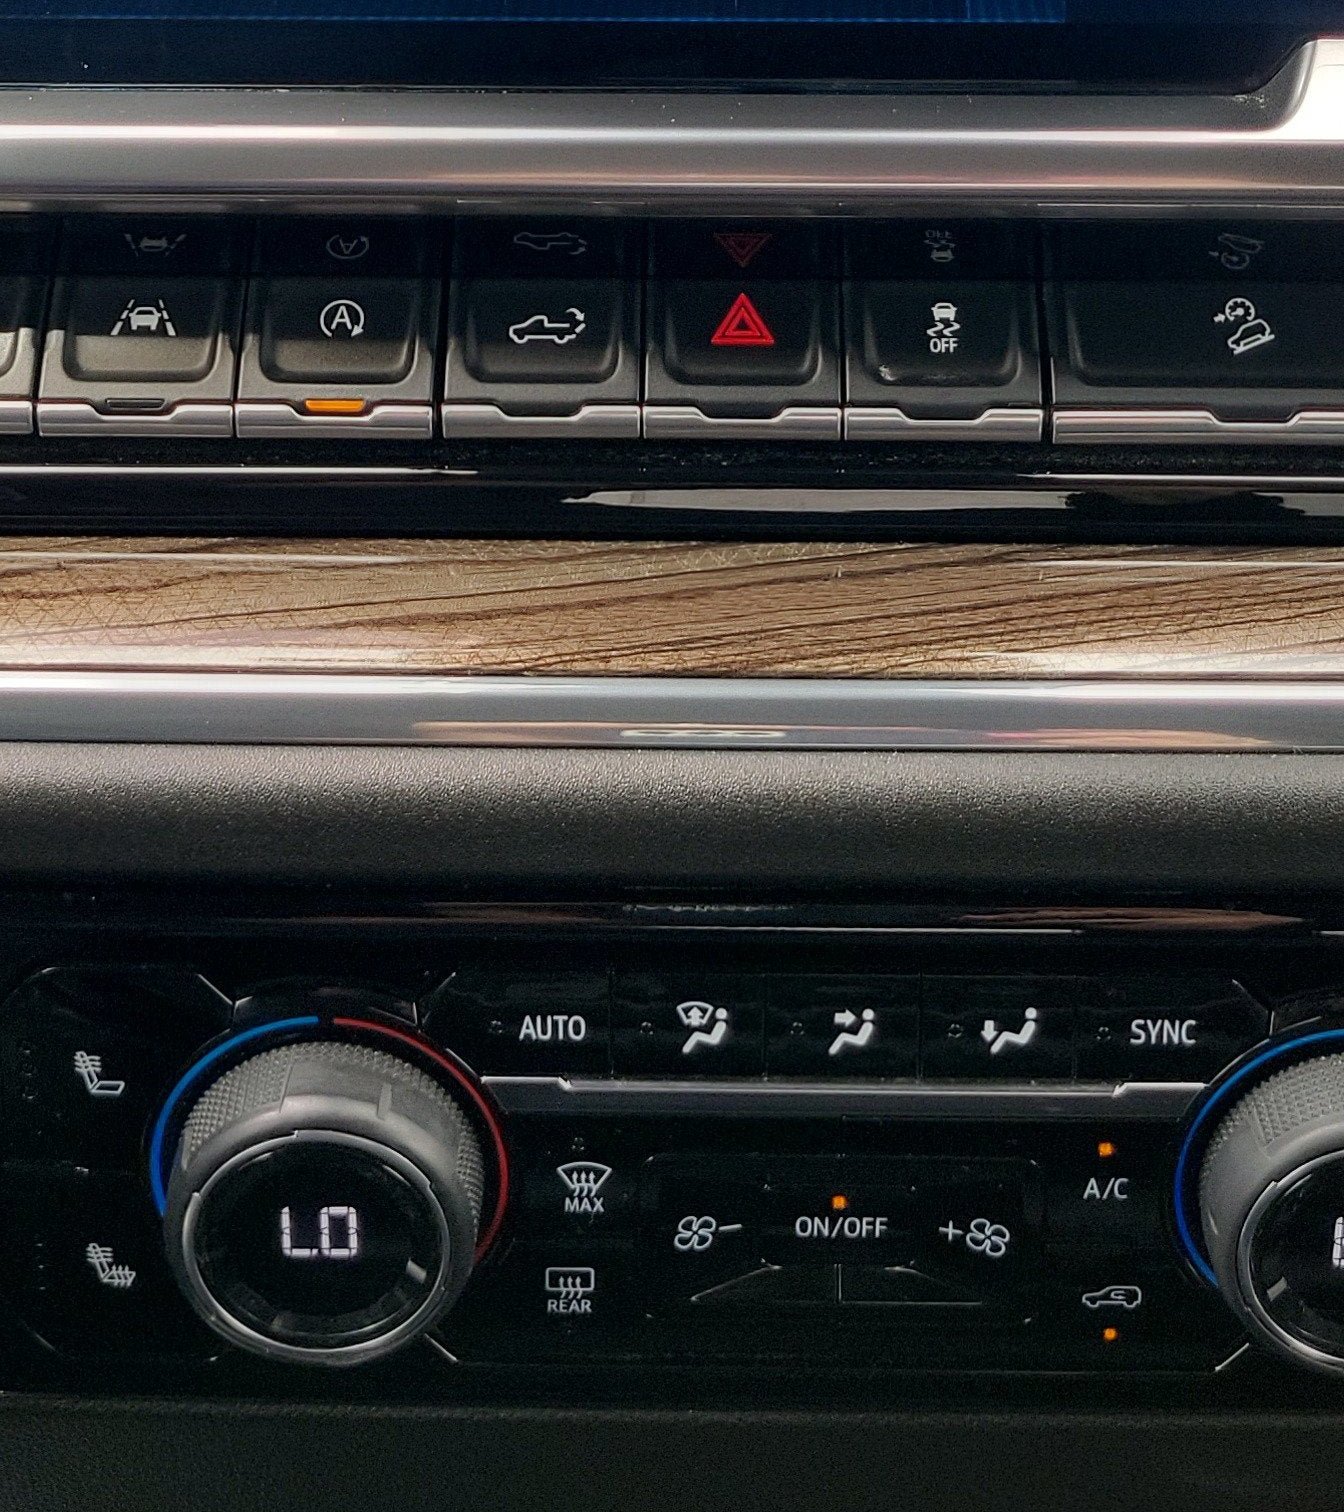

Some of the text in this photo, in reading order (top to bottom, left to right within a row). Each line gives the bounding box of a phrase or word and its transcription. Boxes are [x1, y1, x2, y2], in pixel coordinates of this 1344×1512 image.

[929, 337, 959, 354] OFF
[518, 1014, 587, 1042] AUTO
[1129, 1018, 1197, 1046] SYNC
[1082, 1177, 1129, 1200] A/C
[564, 1196, 605, 1213] MAX
[794, 1215, 888, 1238] ON/OFF
[547, 1299, 592, 1313] REAR
